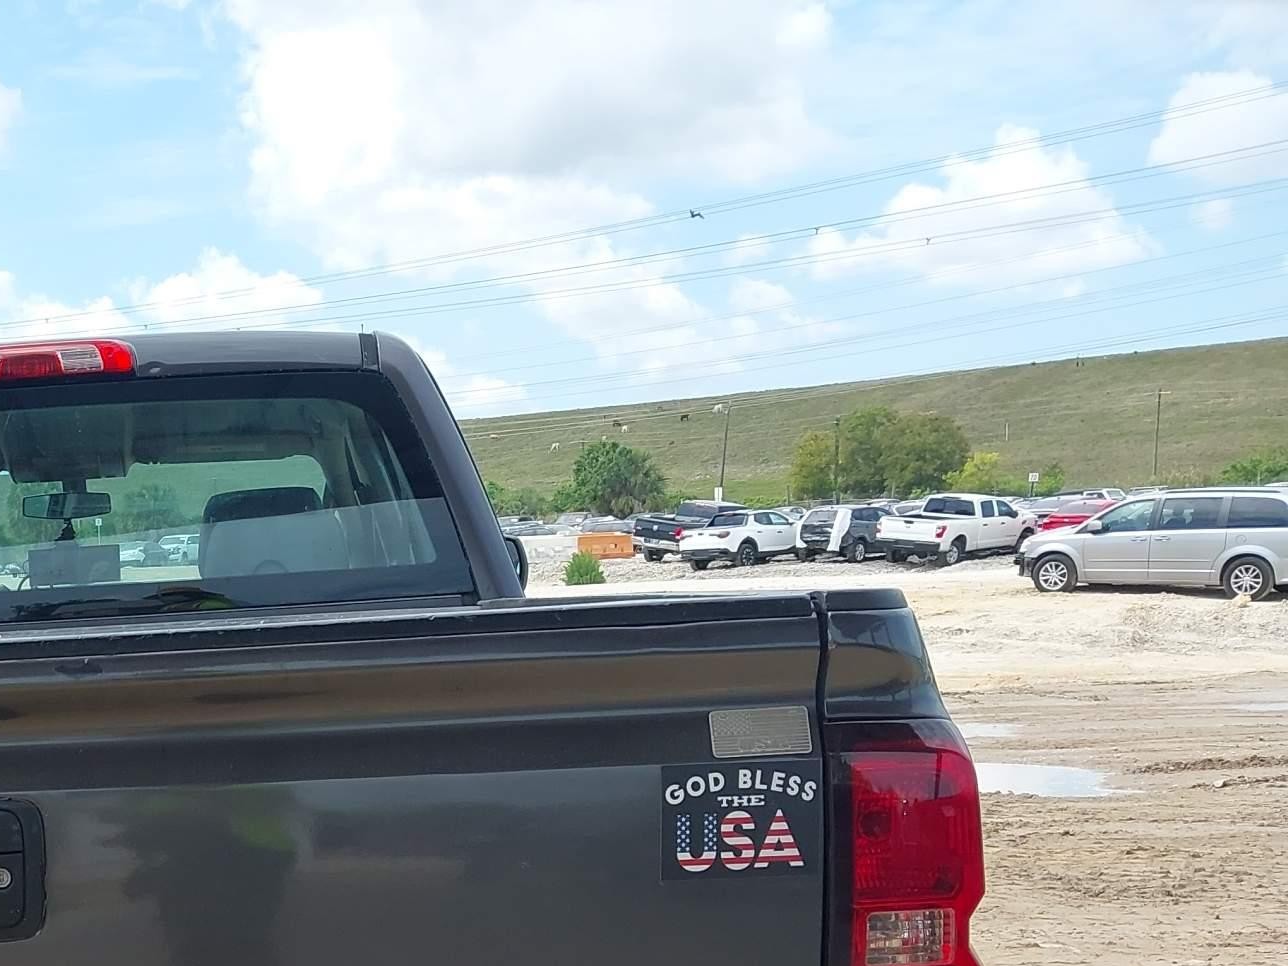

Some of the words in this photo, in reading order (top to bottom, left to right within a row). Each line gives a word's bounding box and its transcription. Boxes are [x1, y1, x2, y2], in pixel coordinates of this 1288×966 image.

[665, 772, 725, 805] GOD
[738, 769, 817, 801] BLESS
[717, 795, 765, 807] THE
[676, 809, 805, 872] USA
